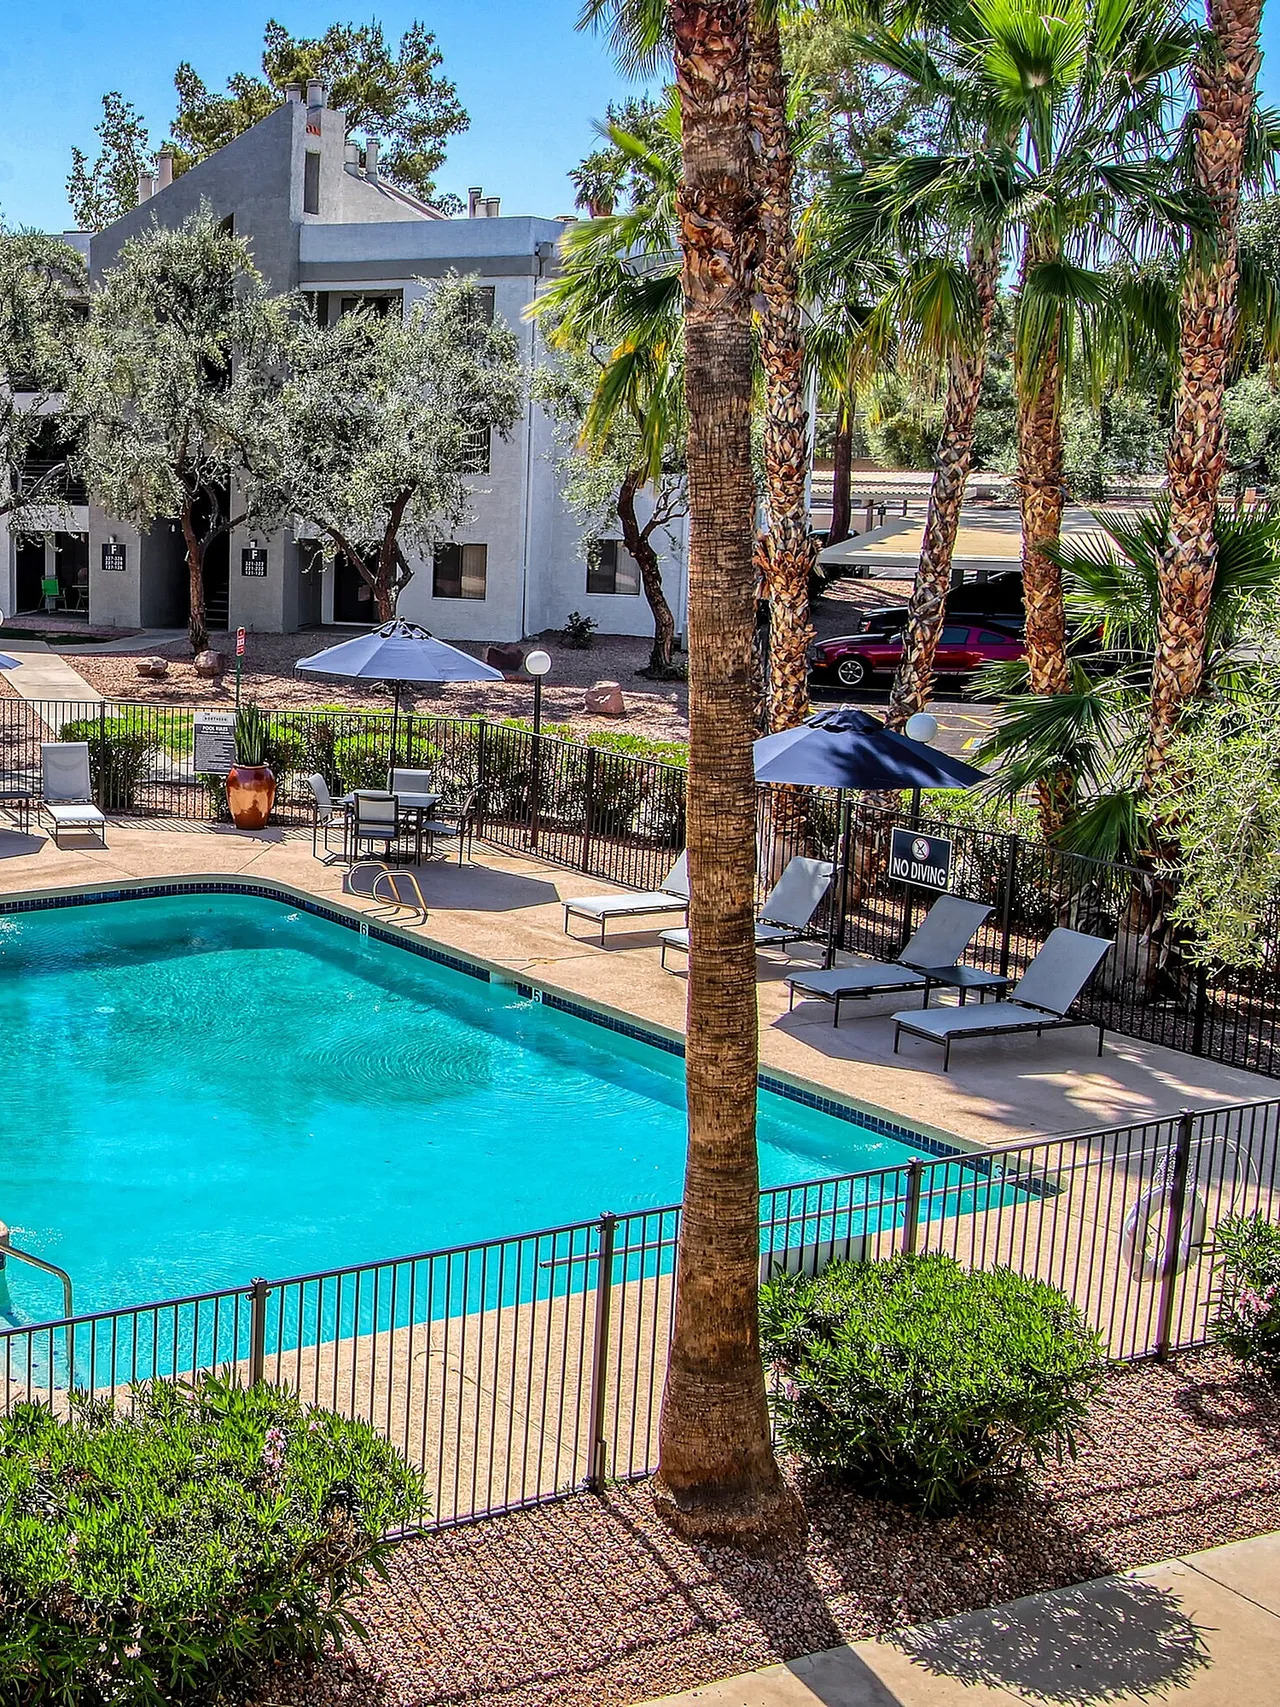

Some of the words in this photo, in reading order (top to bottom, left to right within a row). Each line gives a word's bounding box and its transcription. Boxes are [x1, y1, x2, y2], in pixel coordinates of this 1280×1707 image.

[111, 545, 117, 555] F
[252, 550, 258, 560] F
[892, 857, 909, 877] NO
[910, 861, 946, 887] DIVING
[361, 923, 368, 935] 6
[533, 989, 541, 1002] 5
